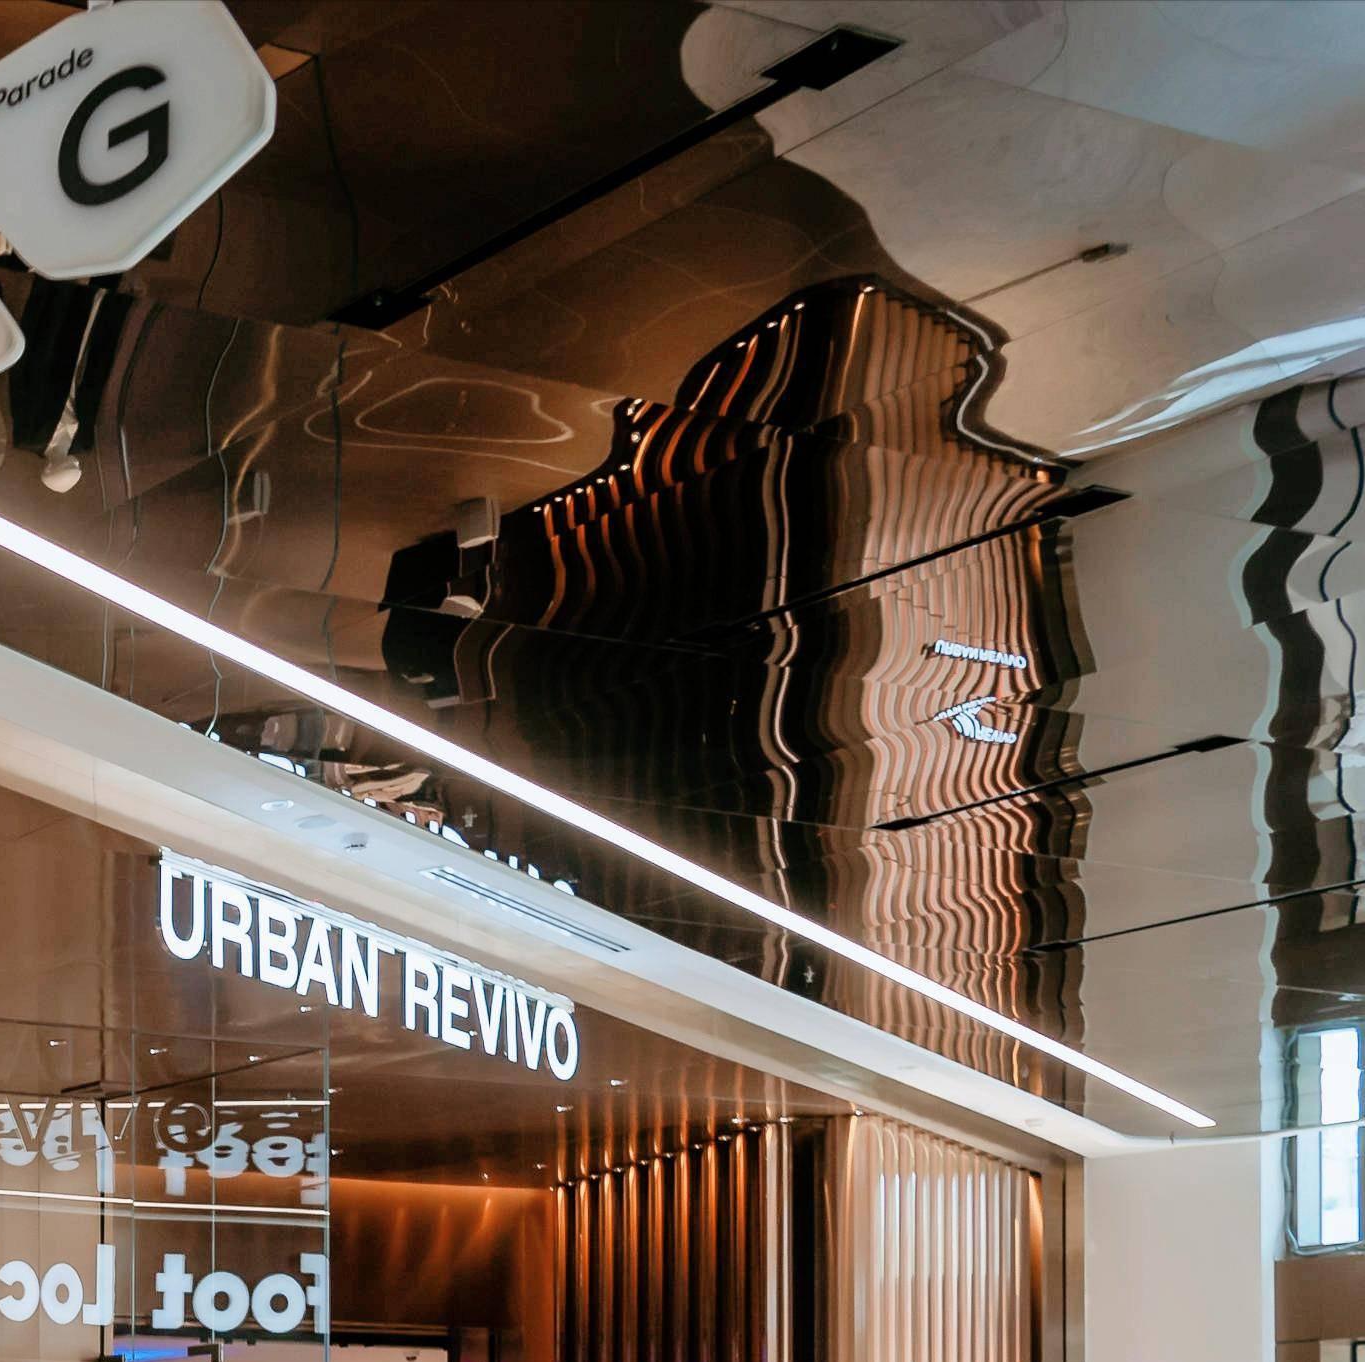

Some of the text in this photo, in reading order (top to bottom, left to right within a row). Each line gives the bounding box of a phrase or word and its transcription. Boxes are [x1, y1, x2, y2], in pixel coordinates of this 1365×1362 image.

[58, 64, 170, 206] G
[159, 864, 579, 1081] URBAN REVIVO
